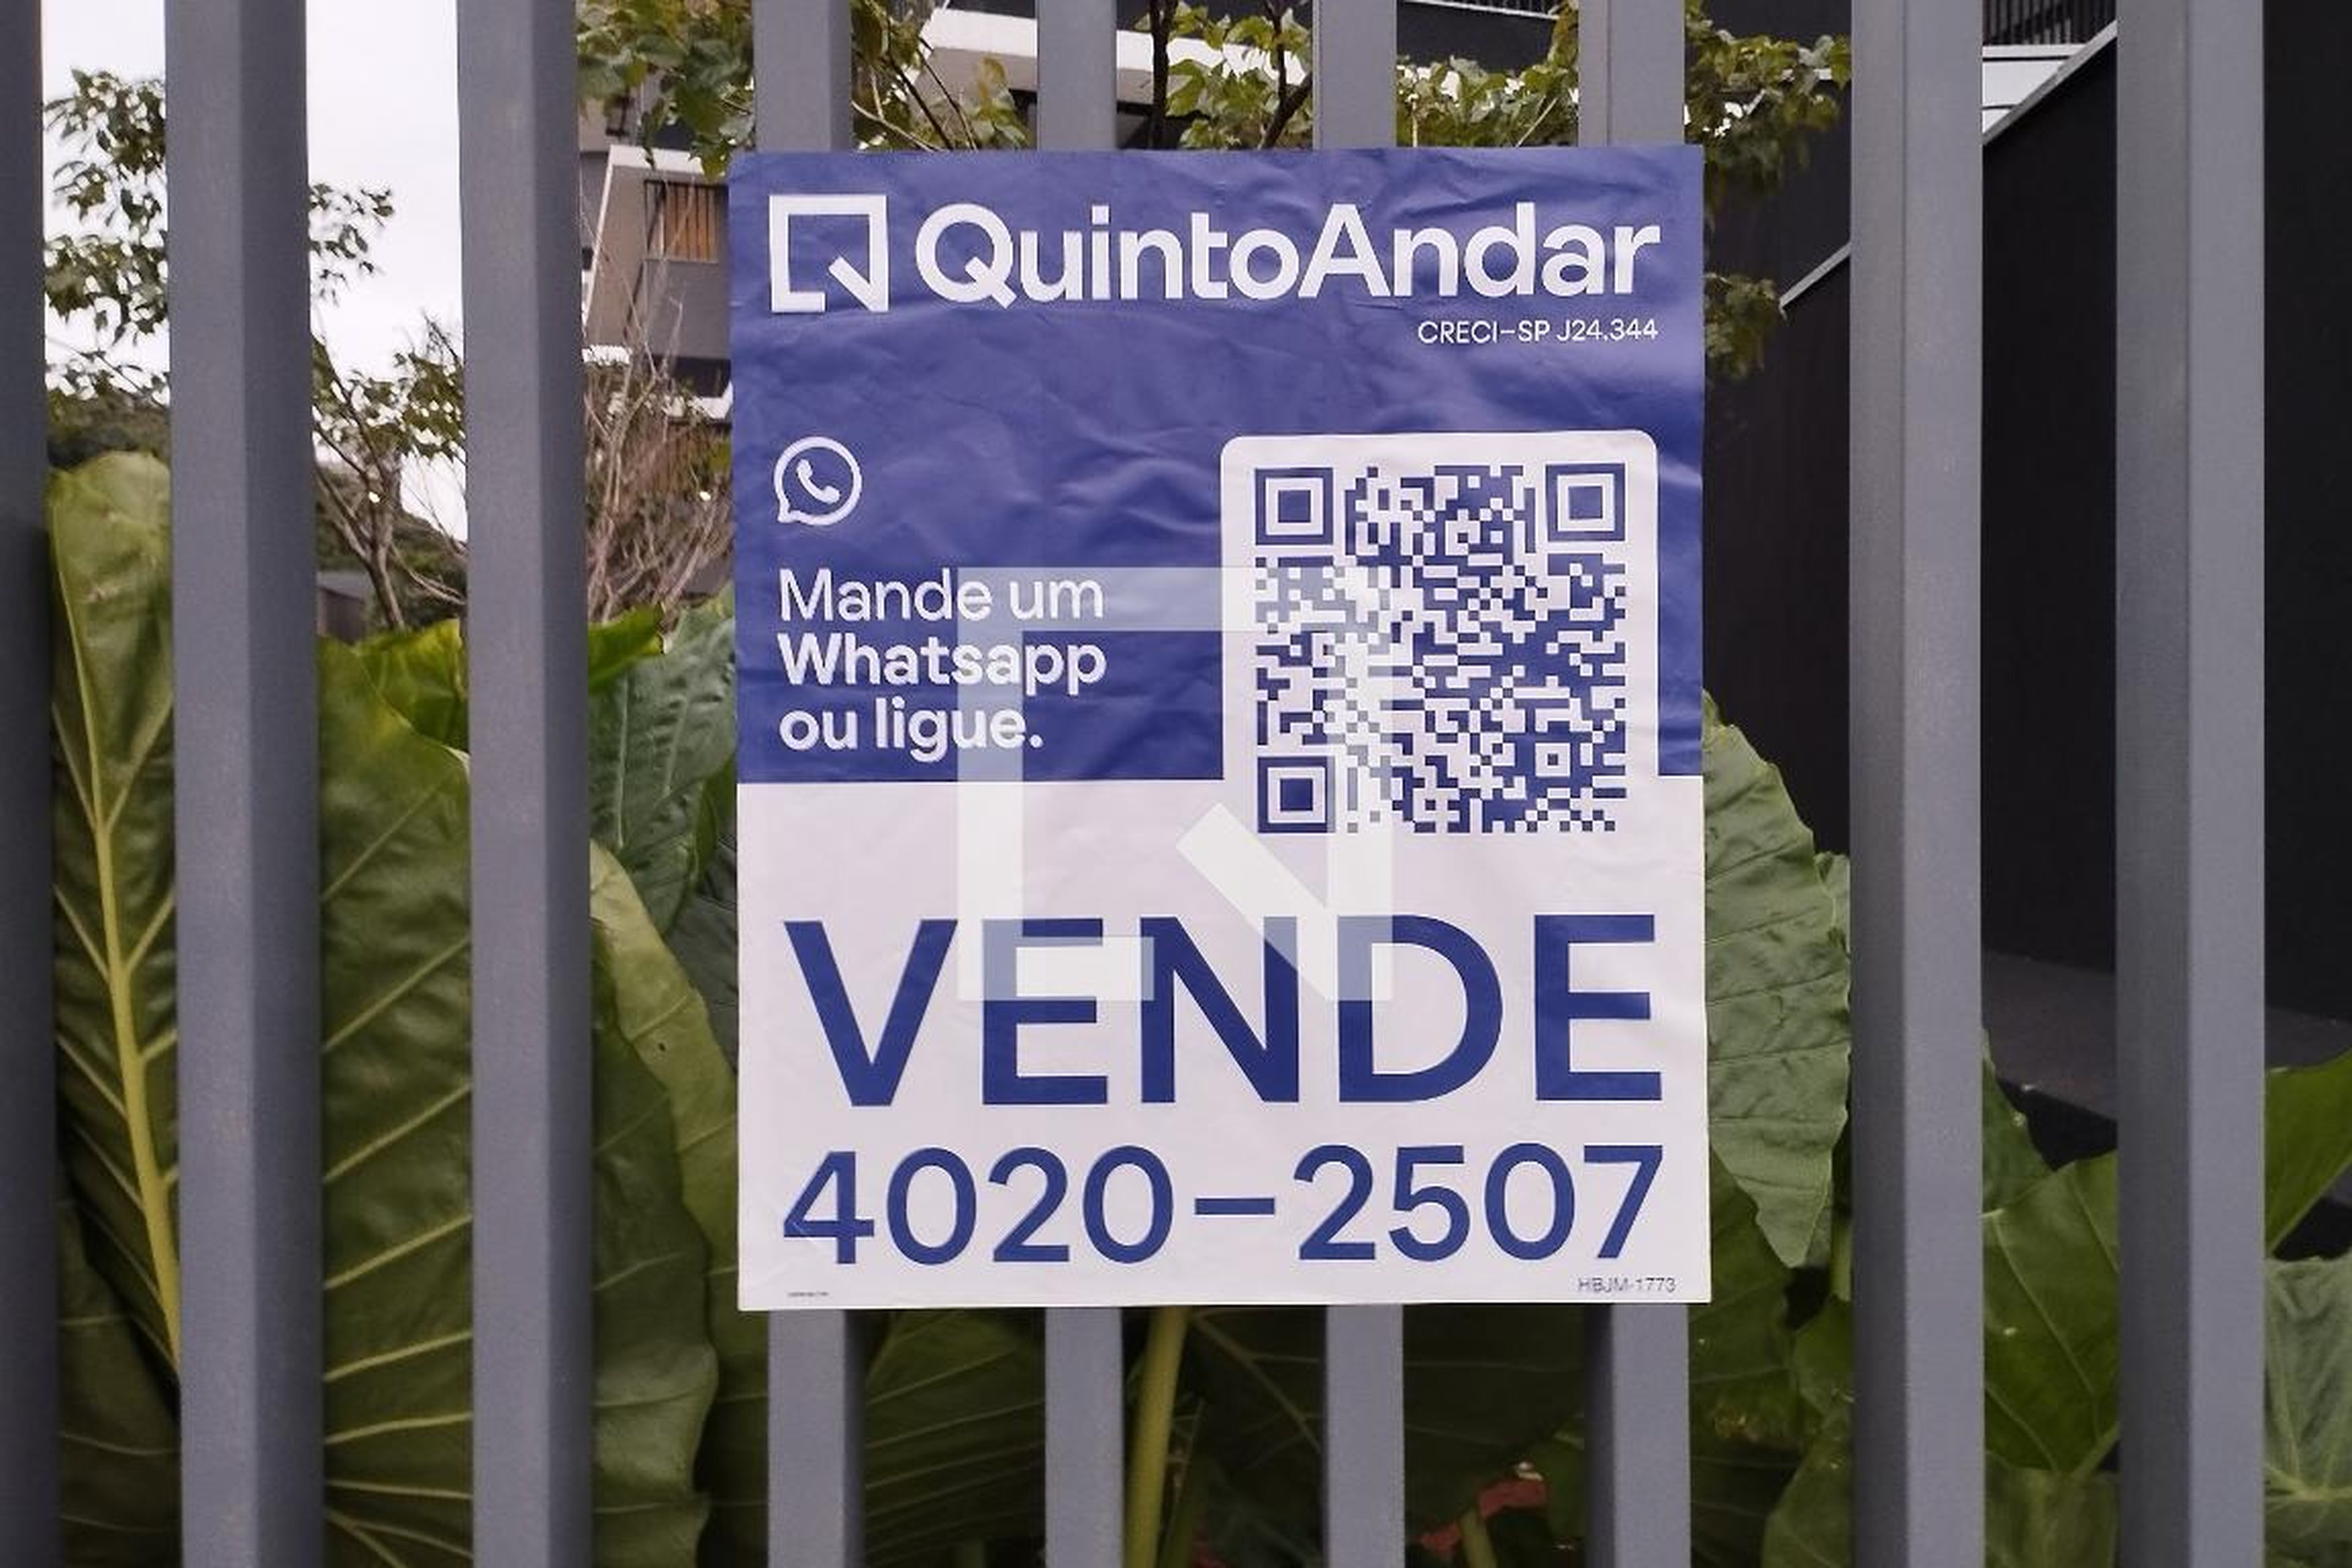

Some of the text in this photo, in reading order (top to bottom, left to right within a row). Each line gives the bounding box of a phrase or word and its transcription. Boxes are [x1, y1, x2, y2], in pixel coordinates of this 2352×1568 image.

[916, 202, 1660, 307] QuintoAndar
[1417, 318, 1659, 344] CRECI-SP J24.344
[778, 568, 1104, 621] Mande um
[776, 632, 1107, 696] Whatsapp
[779, 696, 1043, 763] ou ligue.
[783, 914, 1663, 1107] VENDE
[783, 1143, 1664, 1265] 4020-2507
